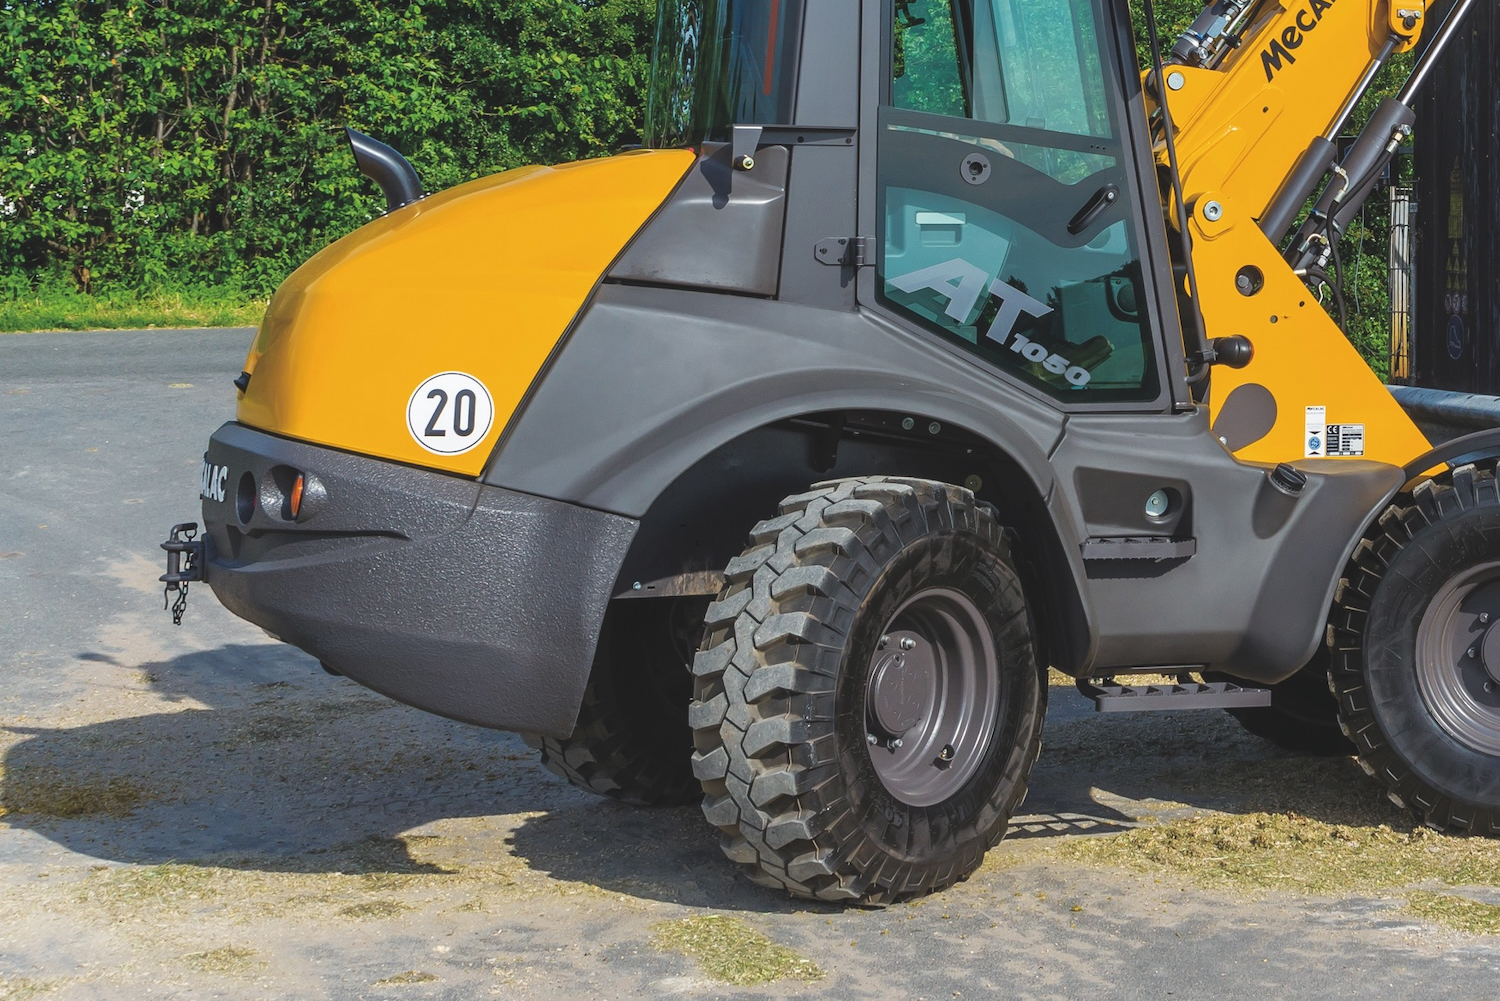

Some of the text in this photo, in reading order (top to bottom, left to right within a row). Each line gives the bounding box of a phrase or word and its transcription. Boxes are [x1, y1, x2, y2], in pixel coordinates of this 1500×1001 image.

[886, 258, 1091, 386] AT 1050
[424, 388, 476, 437] 20
